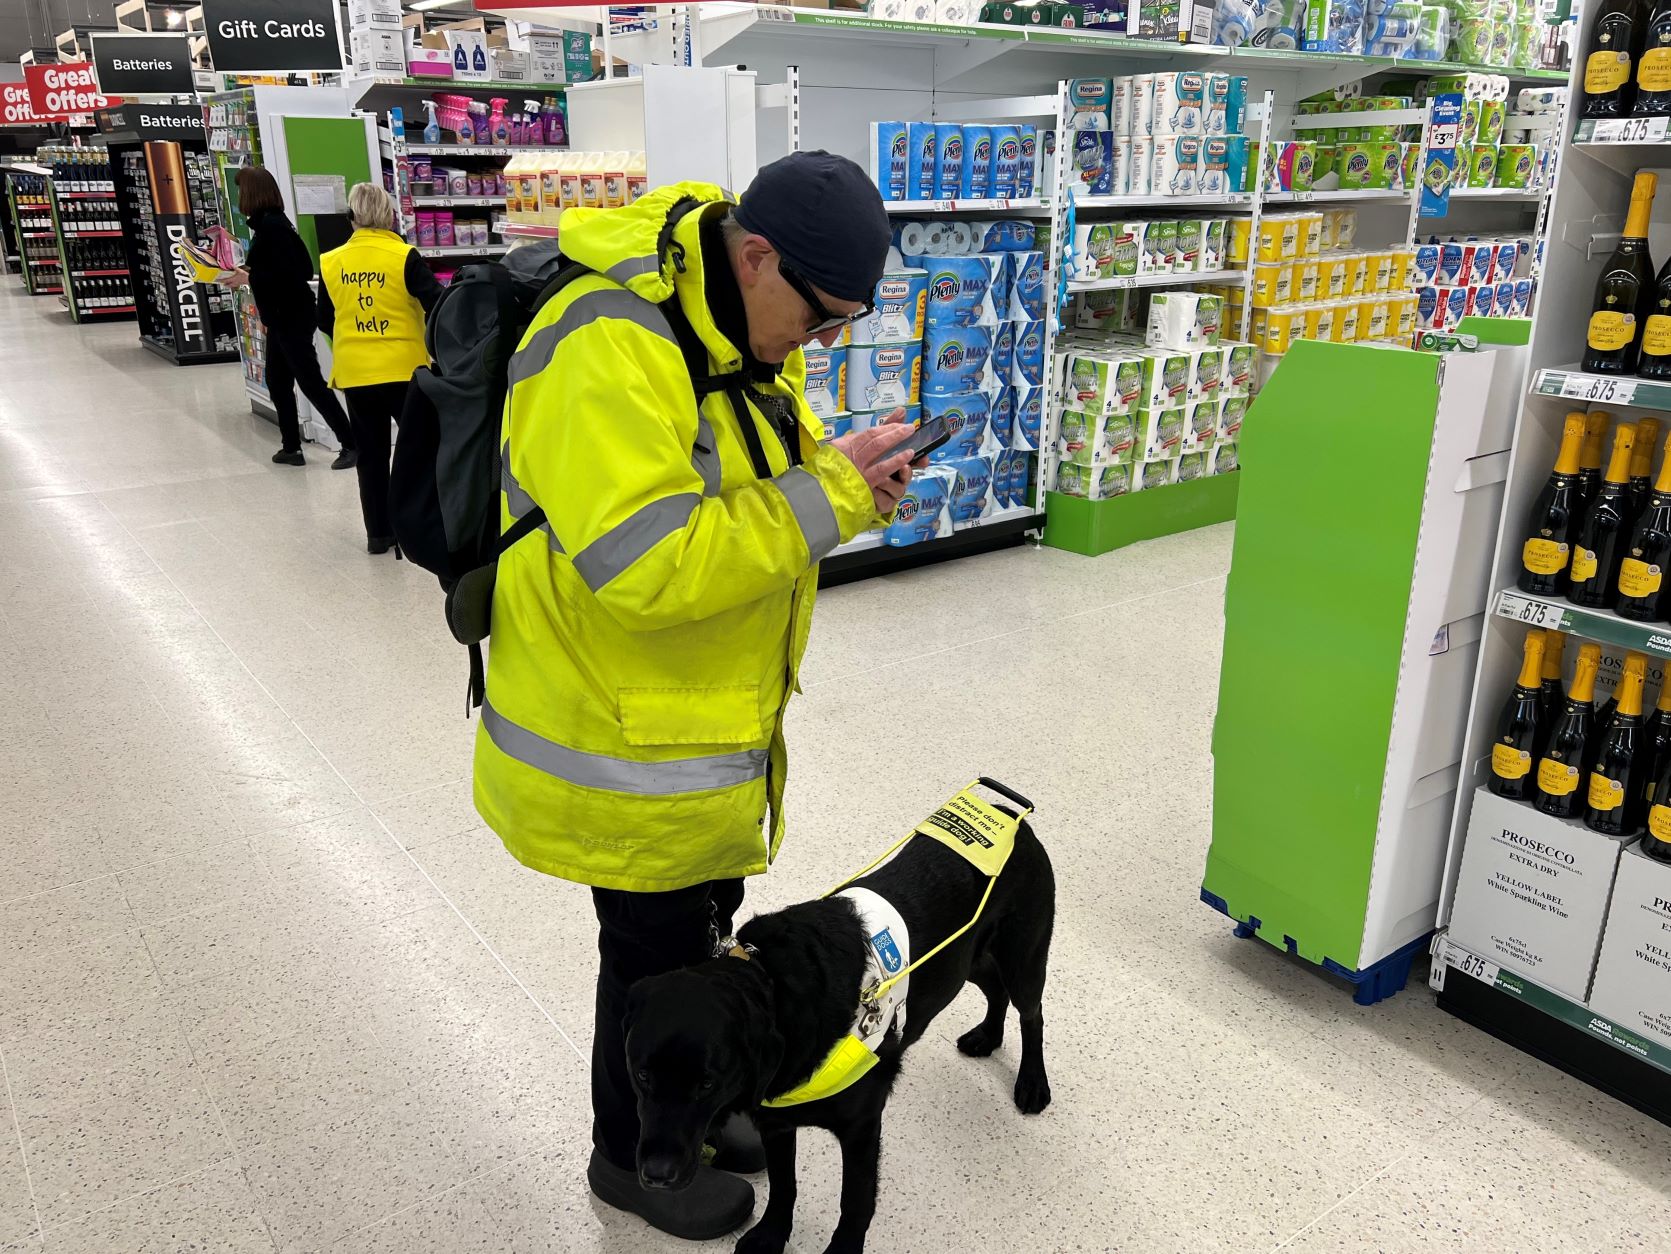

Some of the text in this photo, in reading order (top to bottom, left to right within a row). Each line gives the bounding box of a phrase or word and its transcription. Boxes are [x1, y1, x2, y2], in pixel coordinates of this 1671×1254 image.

[218, 19, 326, 39] Gift Cards
[113, 59, 173, 71] Batteries
[44, 69, 96, 89] Great
[3, 86, 29, 103] Gre
[45, 90, 108, 112] Offers
[140, 114, 205, 128] Batteries
[891, 140, 906, 158] Plen
[922, 141, 935, 158] Ple
[943, 142, 961, 160] Plen
[973, 145, 990, 161] Plen
[996, 164, 1018, 174] MAX
[166, 225, 203, 342] DURACELL
[341, 267, 385, 289] happy
[882, 285, 906, 294] Regina
[930, 282, 960, 302] Plenty
[962, 279, 987, 290] MAX
[357, 292, 374, 311] to
[882, 304, 904, 313] Blitz
[355, 315, 389, 335] help
[1592, 325, 1625, 333] PROSECCO
[937, 350, 964, 371] Plenty
[966, 347, 988, 358] MAX
[806, 379, 828, 389] Blitz
[879, 371, 900, 380] Blitz
[1585, 378, 1618, 401] £6.75
[966, 412, 987, 422] MAX
[967, 475, 988, 489] MAX
[921, 496, 943, 508] MAX
[1518, 601, 1548, 624] £6.75
[1646, 641, 1671, 653] Pound
[948, 801, 991, 831] distract me
[956, 796, 1005, 831] Please don't
[928, 816, 972, 843] guide dog!
[937, 809, 951, 818] I'm
[957, 819, 989, 847] working
[1501, 828, 1575, 864] PROSECCO
[1509, 852, 1560, 878] EXTRA DRY
[1531, 851, 1550, 863] ORIGINE
[1550, 859, 1583, 876] CONTROLLATA
[1495, 871, 1564, 906] YELLOW LABEL
[1487, 878, 1569, 919] White Sparkling Wine
[877, 938, 892, 951] DOGS
[1490, 935, 1505, 946] Case
[1505, 941, 1525, 955] Weight
[1525, 949, 1533, 960] kg
[1495, 943, 1509, 955] WIN
[1508, 936, 1527, 948] 6x75cl
[1635, 949, 1661, 967] White
[1645, 943, 1671, 960] YELL
[1459, 954, 1486, 978] £6.75
[1502, 983, 1522, 995] points
[1638, 1010, 1654, 1021] Case
[1590, 1017, 1650, 1051] ASDA Rewards
[1643, 1020, 1659, 1032] WIN
[1588, 1023, 1648, 1057] Pounds, not points
